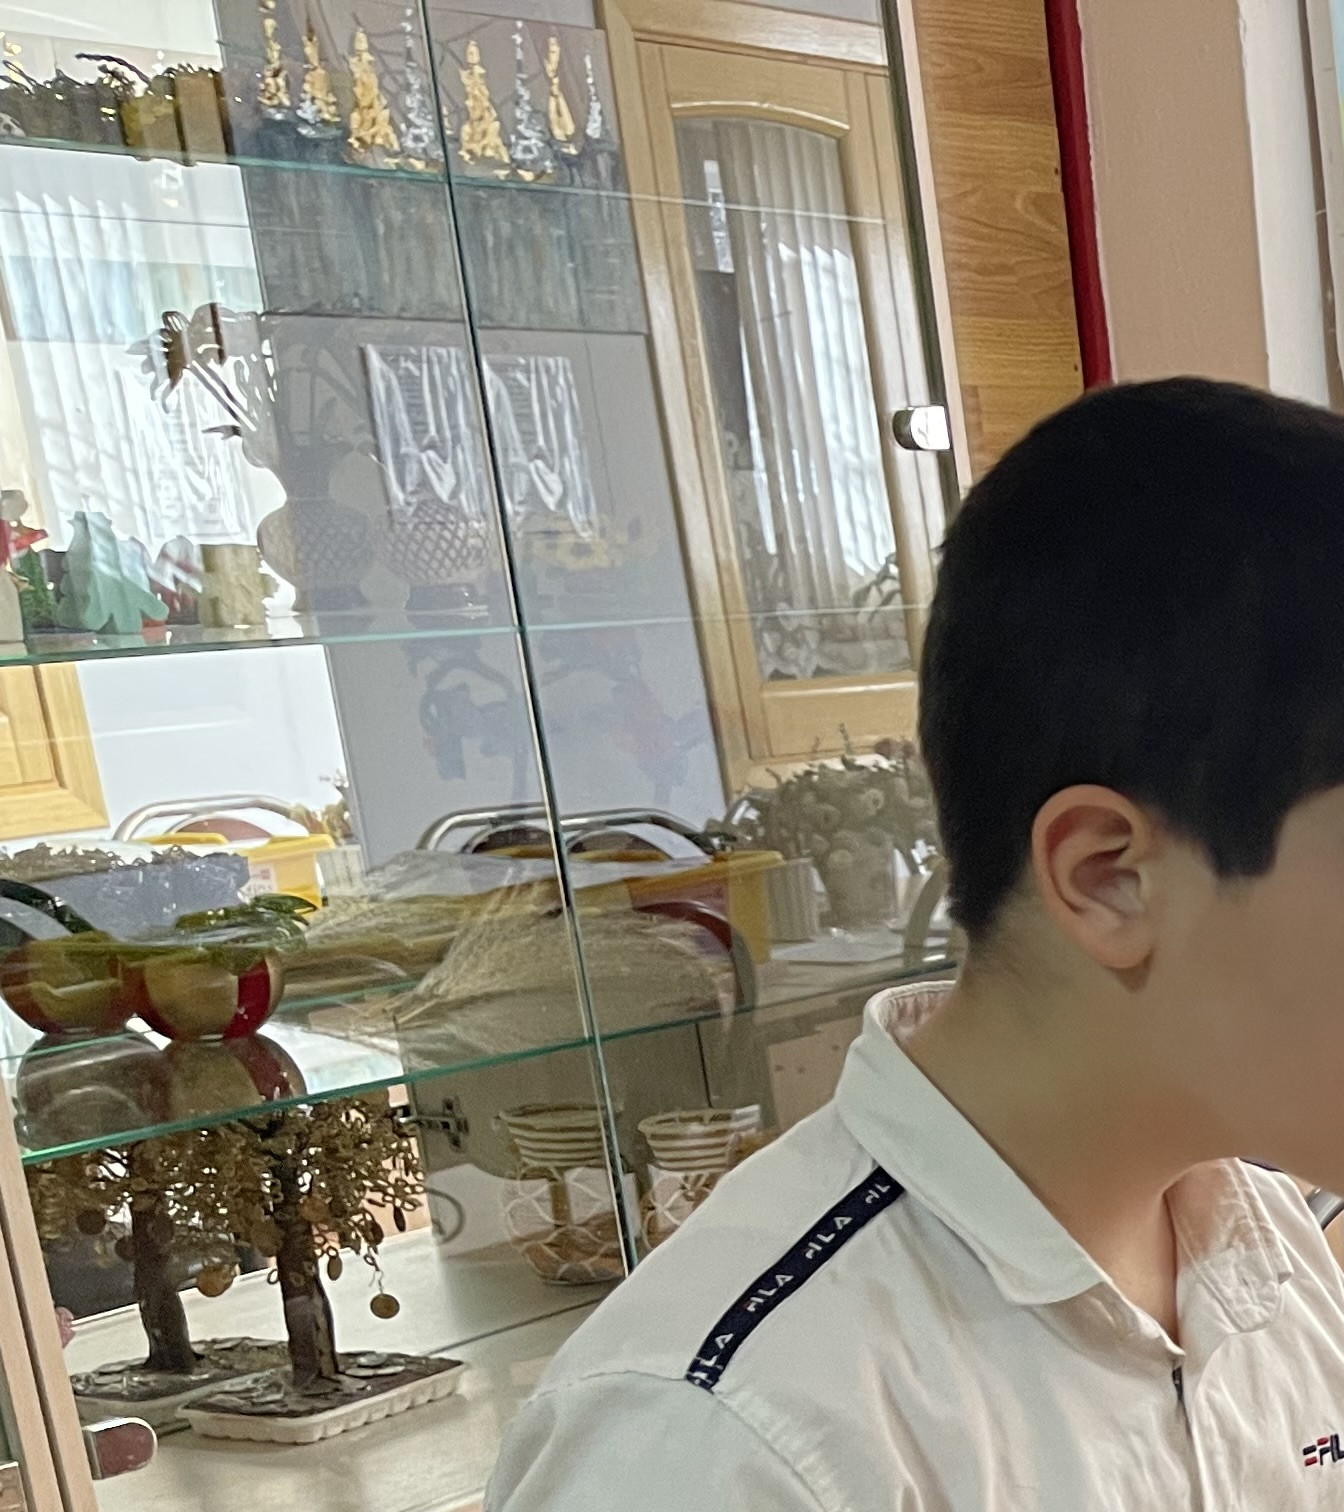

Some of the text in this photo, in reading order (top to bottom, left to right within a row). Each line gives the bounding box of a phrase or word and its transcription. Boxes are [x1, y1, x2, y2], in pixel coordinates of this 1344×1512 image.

[747, 1274, 795, 1313] FILA
[805, 1216, 854, 1260] FILA
[865, 1182, 892, 1205] FIL
